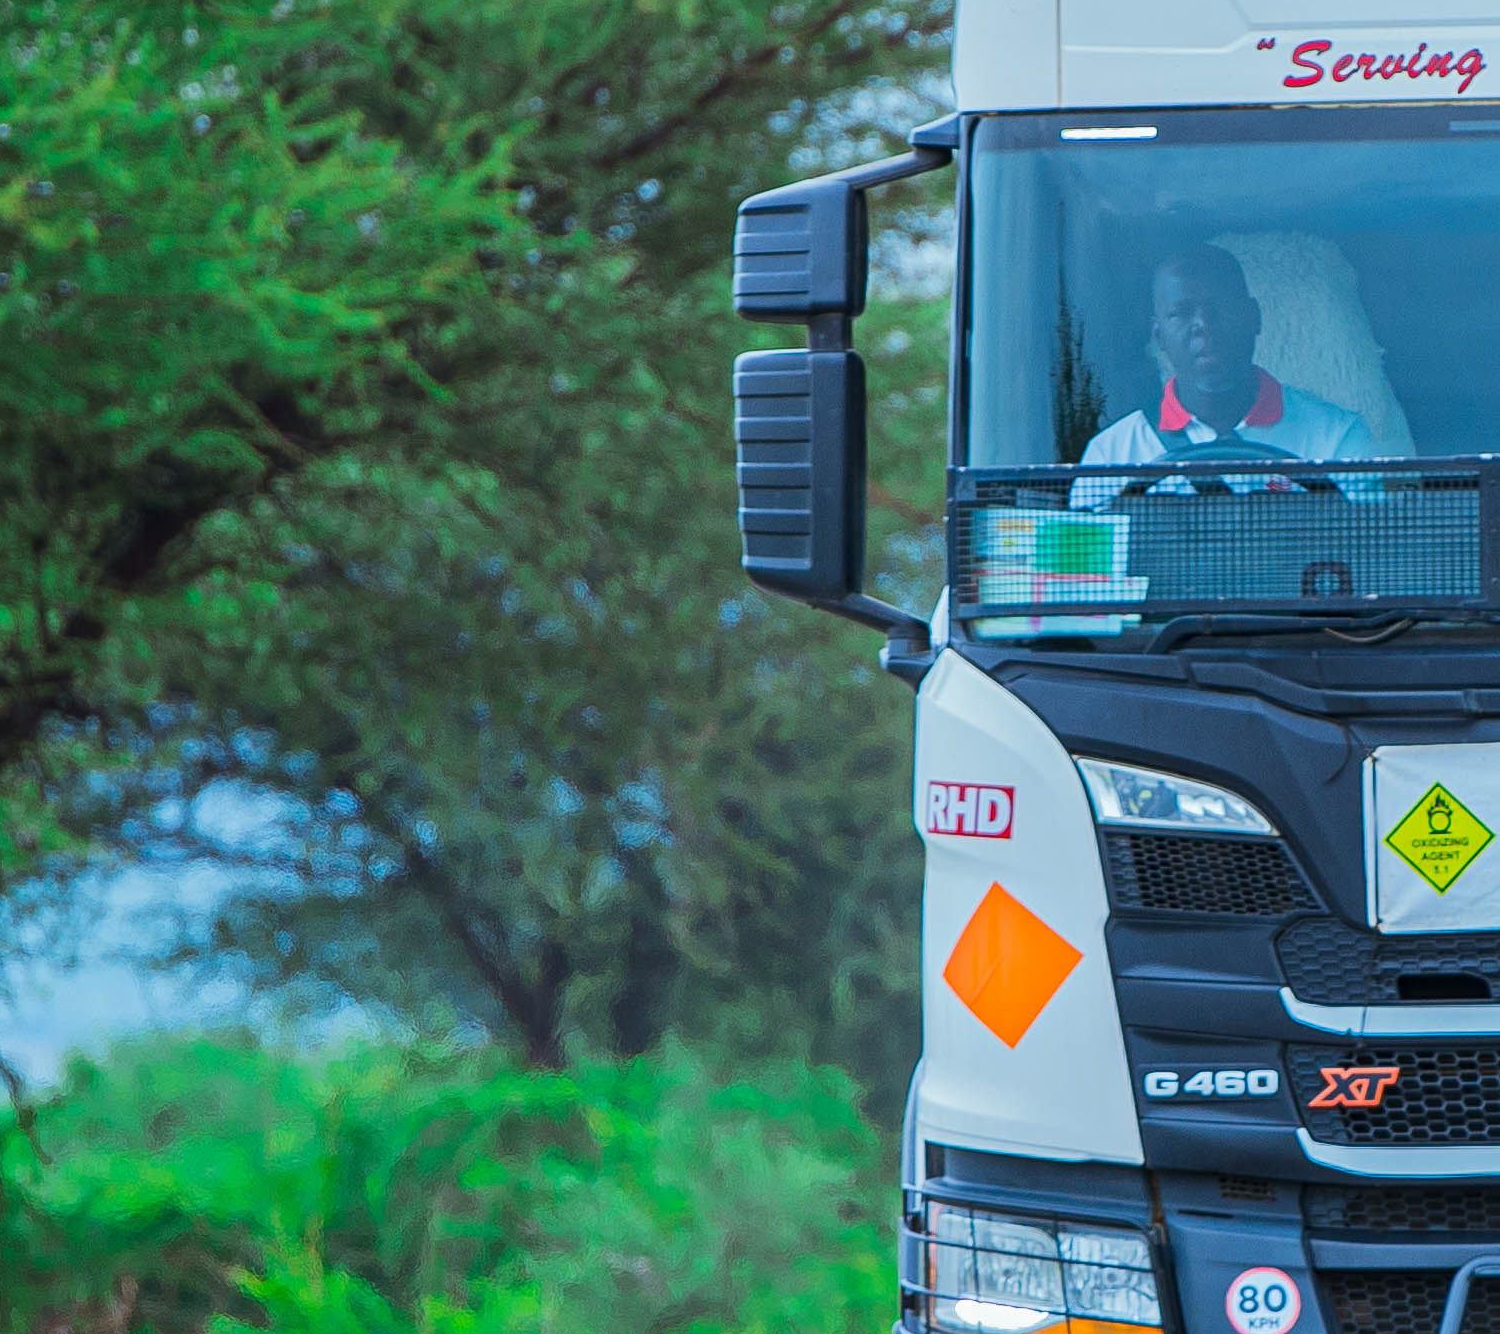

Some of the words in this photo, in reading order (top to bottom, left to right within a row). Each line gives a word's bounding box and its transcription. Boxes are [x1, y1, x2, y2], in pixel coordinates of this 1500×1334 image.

[926, 783, 1012, 836] RHD
[1144, 1071, 1179, 1097] G
[1183, 1069, 1279, 1097] 460
[1308, 1067, 1400, 1107] XT
[1239, 1284, 1287, 1313] 80
[1249, 1317, 1279, 1329] KPH
